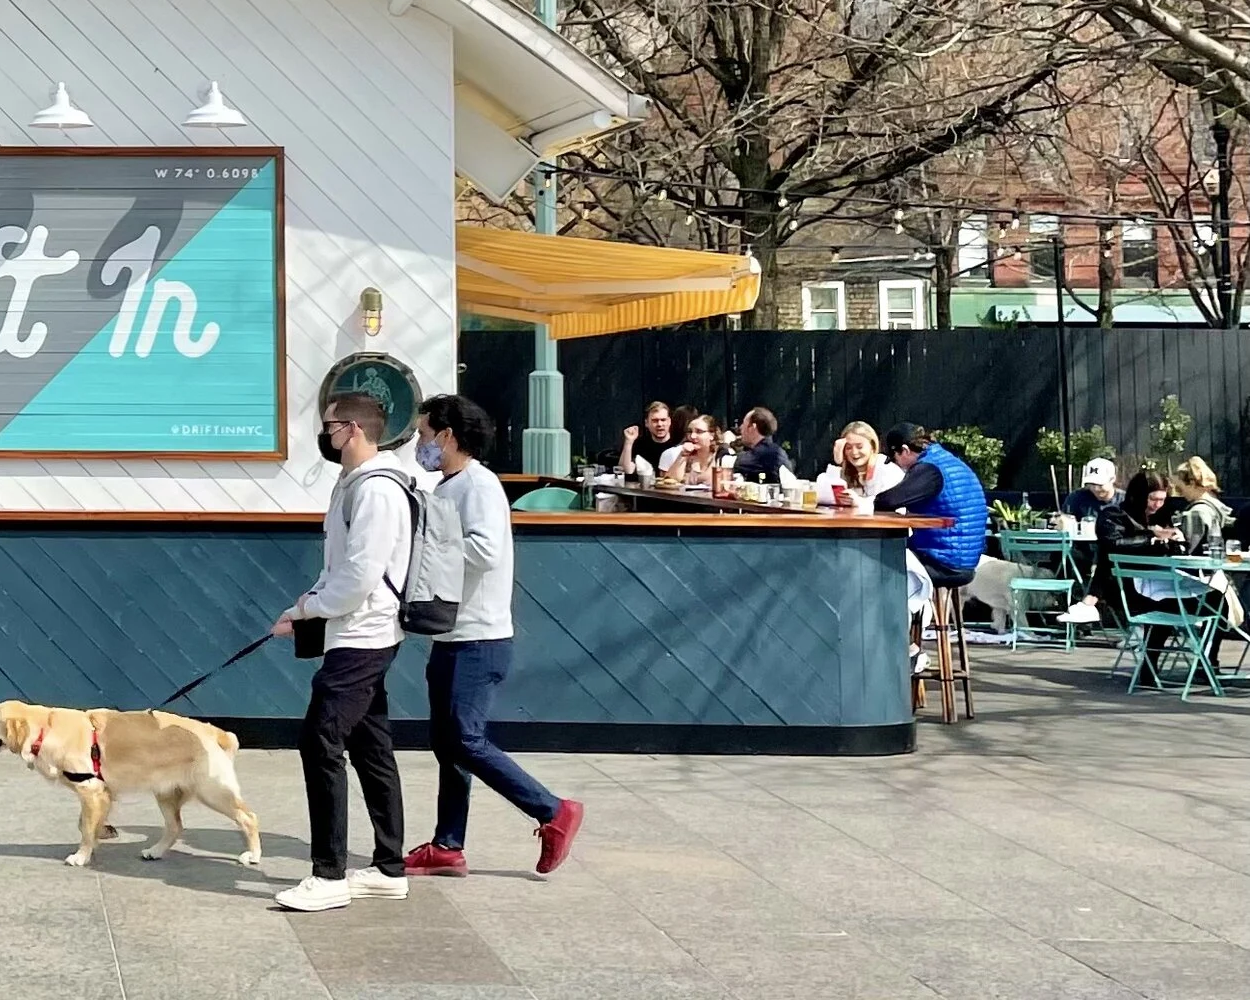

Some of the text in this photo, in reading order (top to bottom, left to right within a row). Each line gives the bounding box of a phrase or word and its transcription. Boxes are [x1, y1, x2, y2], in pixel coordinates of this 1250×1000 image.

[154, 168, 168, 179] W
[101, 225, 220, 358] In
[171, 424, 263, 436] @DRIFTINNYC
